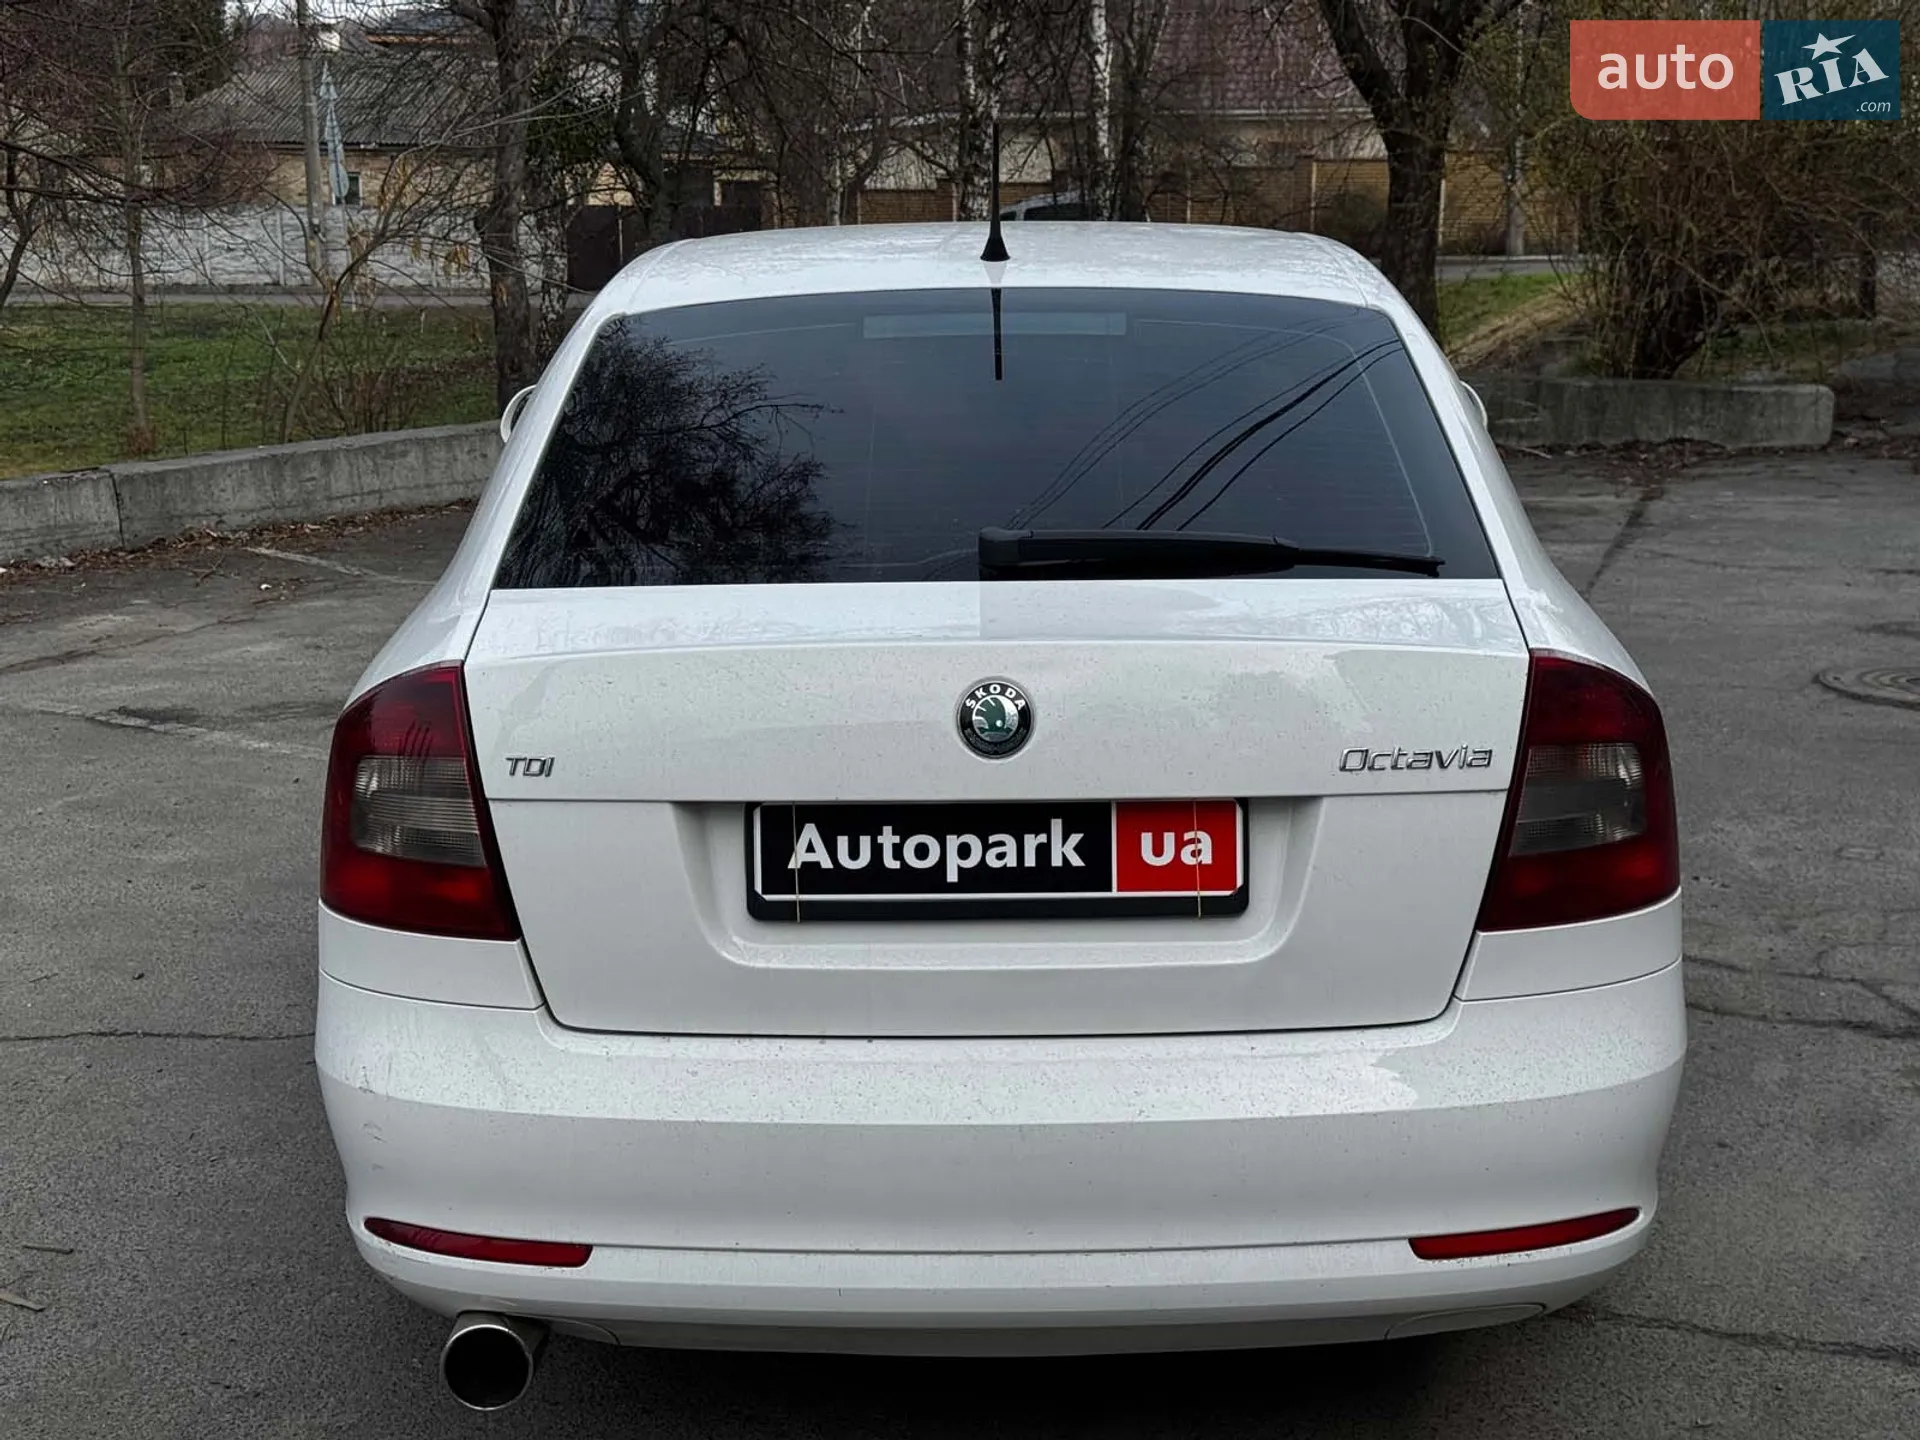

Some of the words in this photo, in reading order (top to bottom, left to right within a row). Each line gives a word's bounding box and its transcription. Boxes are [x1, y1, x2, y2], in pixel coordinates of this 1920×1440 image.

[505, 756, 555, 777] TDI
[1339, 744, 1493, 772] Octavia
[787, 818, 1086, 882] Autopark
[1140, 830, 1213, 867] ua
